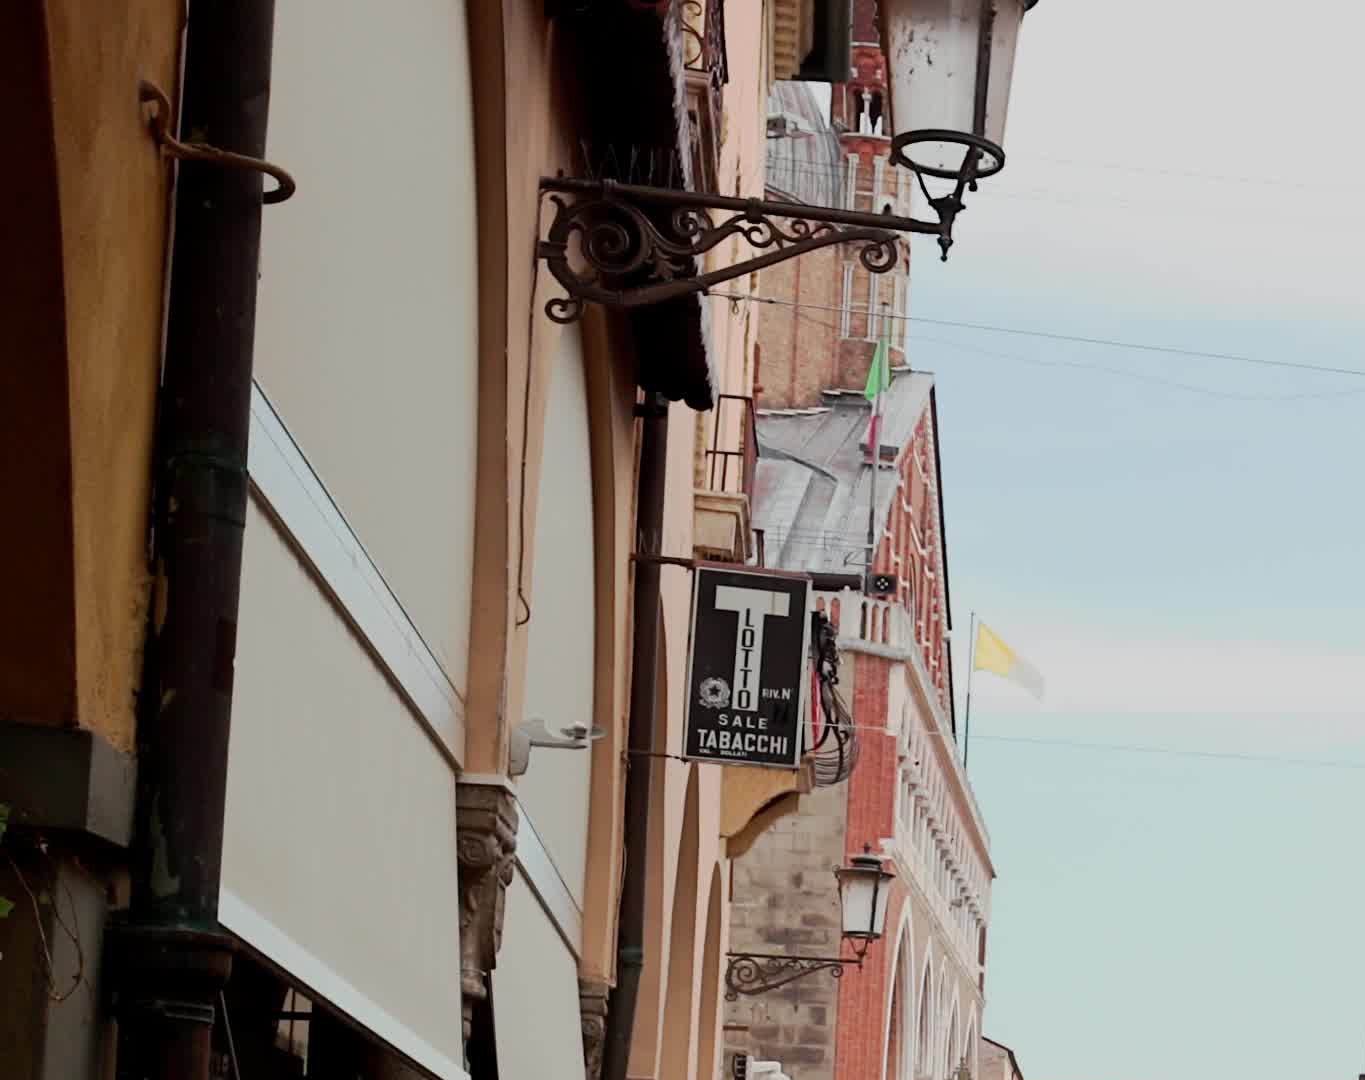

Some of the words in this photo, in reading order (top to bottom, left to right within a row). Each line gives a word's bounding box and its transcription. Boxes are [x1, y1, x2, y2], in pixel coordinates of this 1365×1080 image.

[738, 608, 755, 709] LOTTO
[718, 713, 768, 730] SALE
[697, 728, 788, 755] TABACCHI
